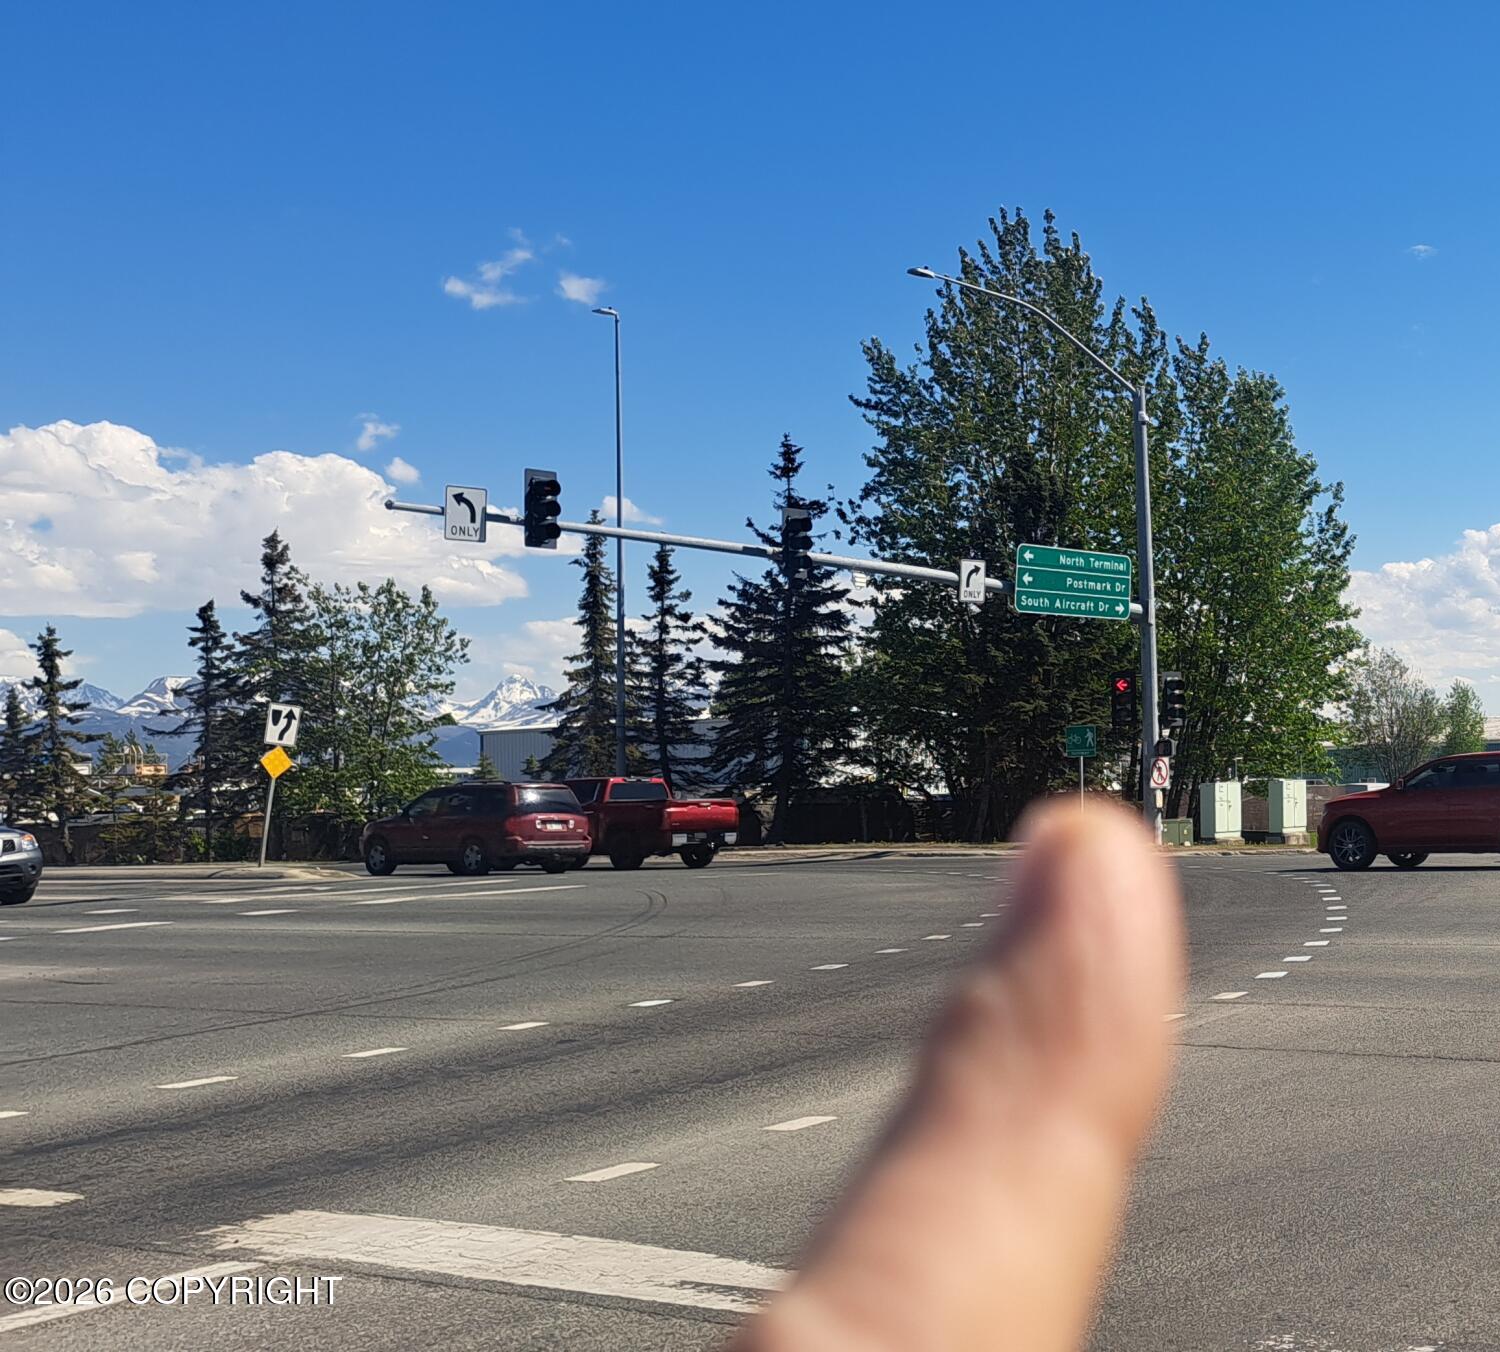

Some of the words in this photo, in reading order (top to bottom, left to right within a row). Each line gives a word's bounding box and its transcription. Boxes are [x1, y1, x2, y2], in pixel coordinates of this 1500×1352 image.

[450, 525, 480, 537] ONLY
[1059, 554, 1085, 567] North
[1089, 558, 1127, 571] Terminal
[1066, 577, 1112, 591] Postmark
[1115, 580, 1126, 592] Dr
[963, 589, 981, 599] ONLY
[1020, 595, 1050, 608] South
[1054, 598, 1095, 612] Aircraft
[1098, 601, 1110, 612] Dr
